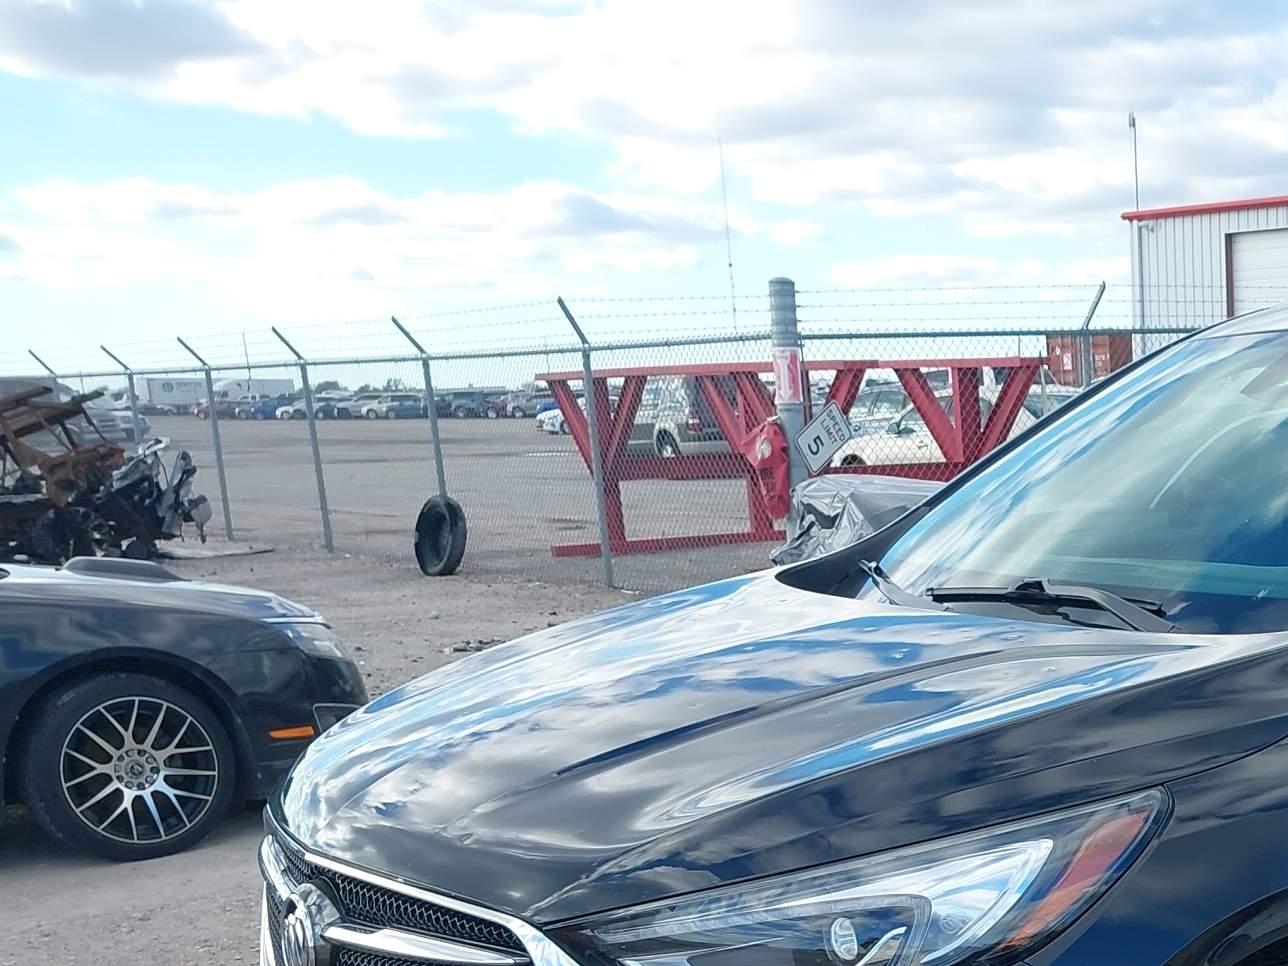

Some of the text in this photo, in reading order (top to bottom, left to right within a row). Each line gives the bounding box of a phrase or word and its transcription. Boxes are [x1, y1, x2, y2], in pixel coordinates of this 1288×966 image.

[820, 418, 838, 445] LIMIT
[825, 409, 846, 442] SPEED
[807, 434, 825, 456] 5
